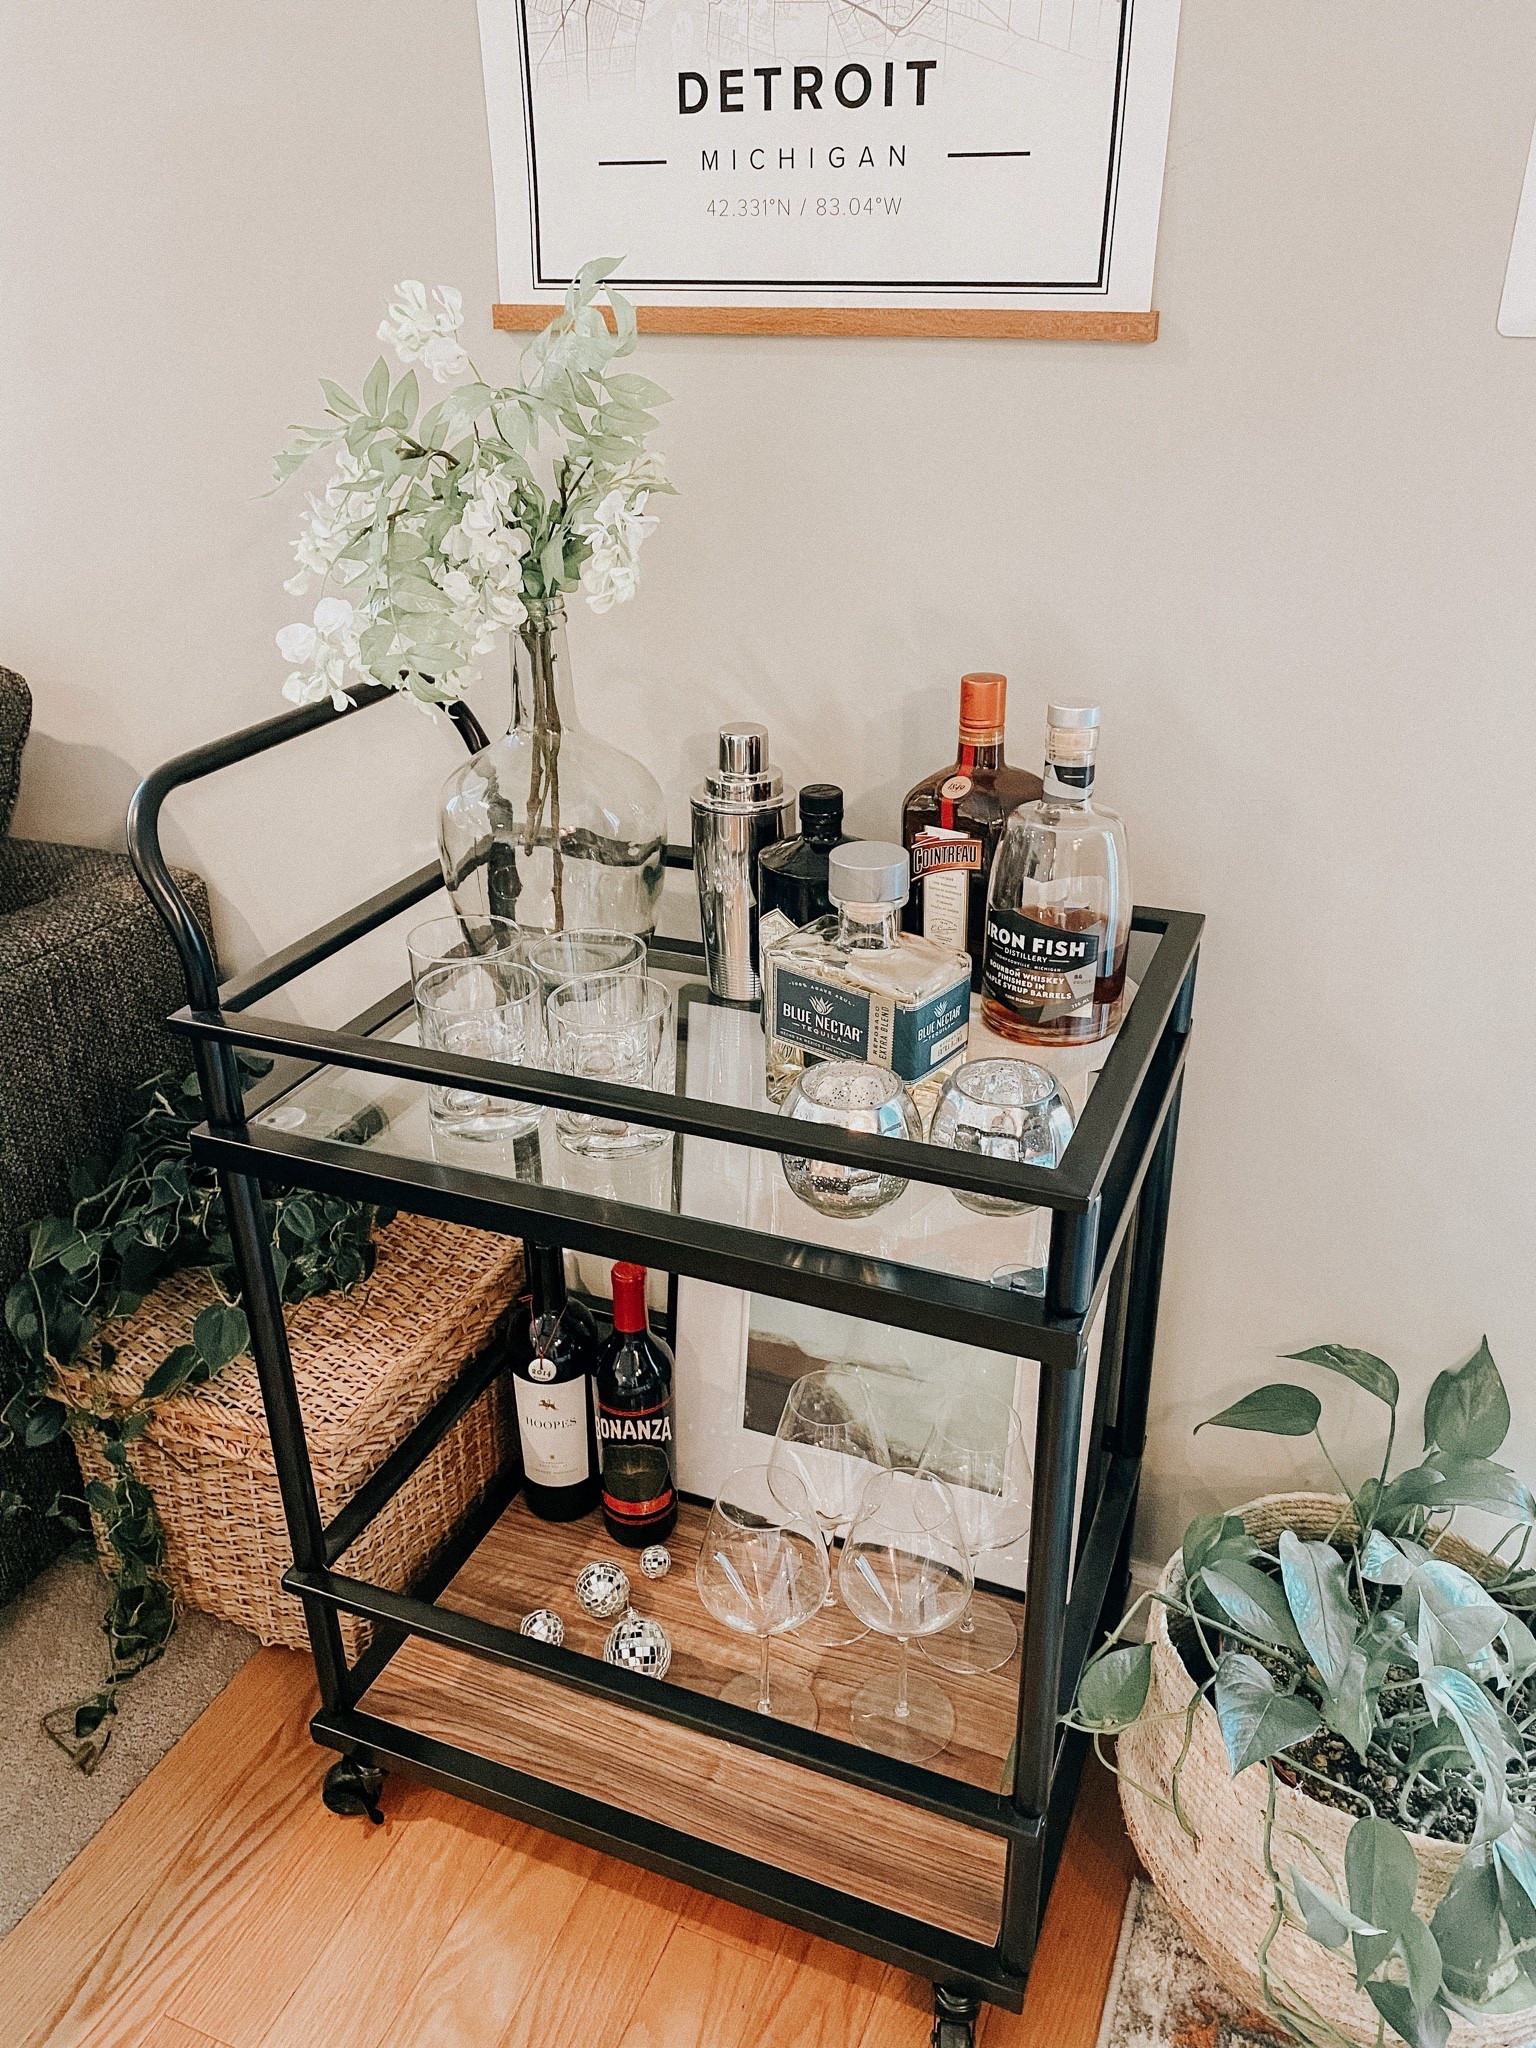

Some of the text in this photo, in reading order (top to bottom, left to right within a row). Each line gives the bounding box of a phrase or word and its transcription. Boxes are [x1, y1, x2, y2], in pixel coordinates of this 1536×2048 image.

[678, 60, 938, 115] DETROIT
[701, 144, 906, 171] MICHIGAN
[706, 198, 791, 217] 42.331°N
[816, 196, 902, 216] 83.04°W
[913, 844, 977, 874] COINTREAU
[987, 920, 1086, 958] IRON FISH
[1004, 947, 1049, 964] DISTILLERY
[989, 959, 1066, 986] BOURBON WHISKEY
[997, 970, 1033, 989] FINISHED
[1035, 982, 1046, 991] IN
[810, 985, 832, 996] AGAVE
[1002, 983, 1029, 995] SYRUP
[1030, 989, 1072, 1000] BARRELS
[783, 1002, 860, 1043] BLUE NECTAR
[801, 1023, 842, 1043] TEQUILA
[878, 1006, 890, 1060] EXTRA BLEND
[917, 1021, 936, 1041] BLUE
[936, 1005, 961, 1029] NECTAR
[531, 1368, 552, 1378] 2014
[525, 1416, 577, 1431] HOOPES
[595, 1415, 673, 1442] BONANZA
